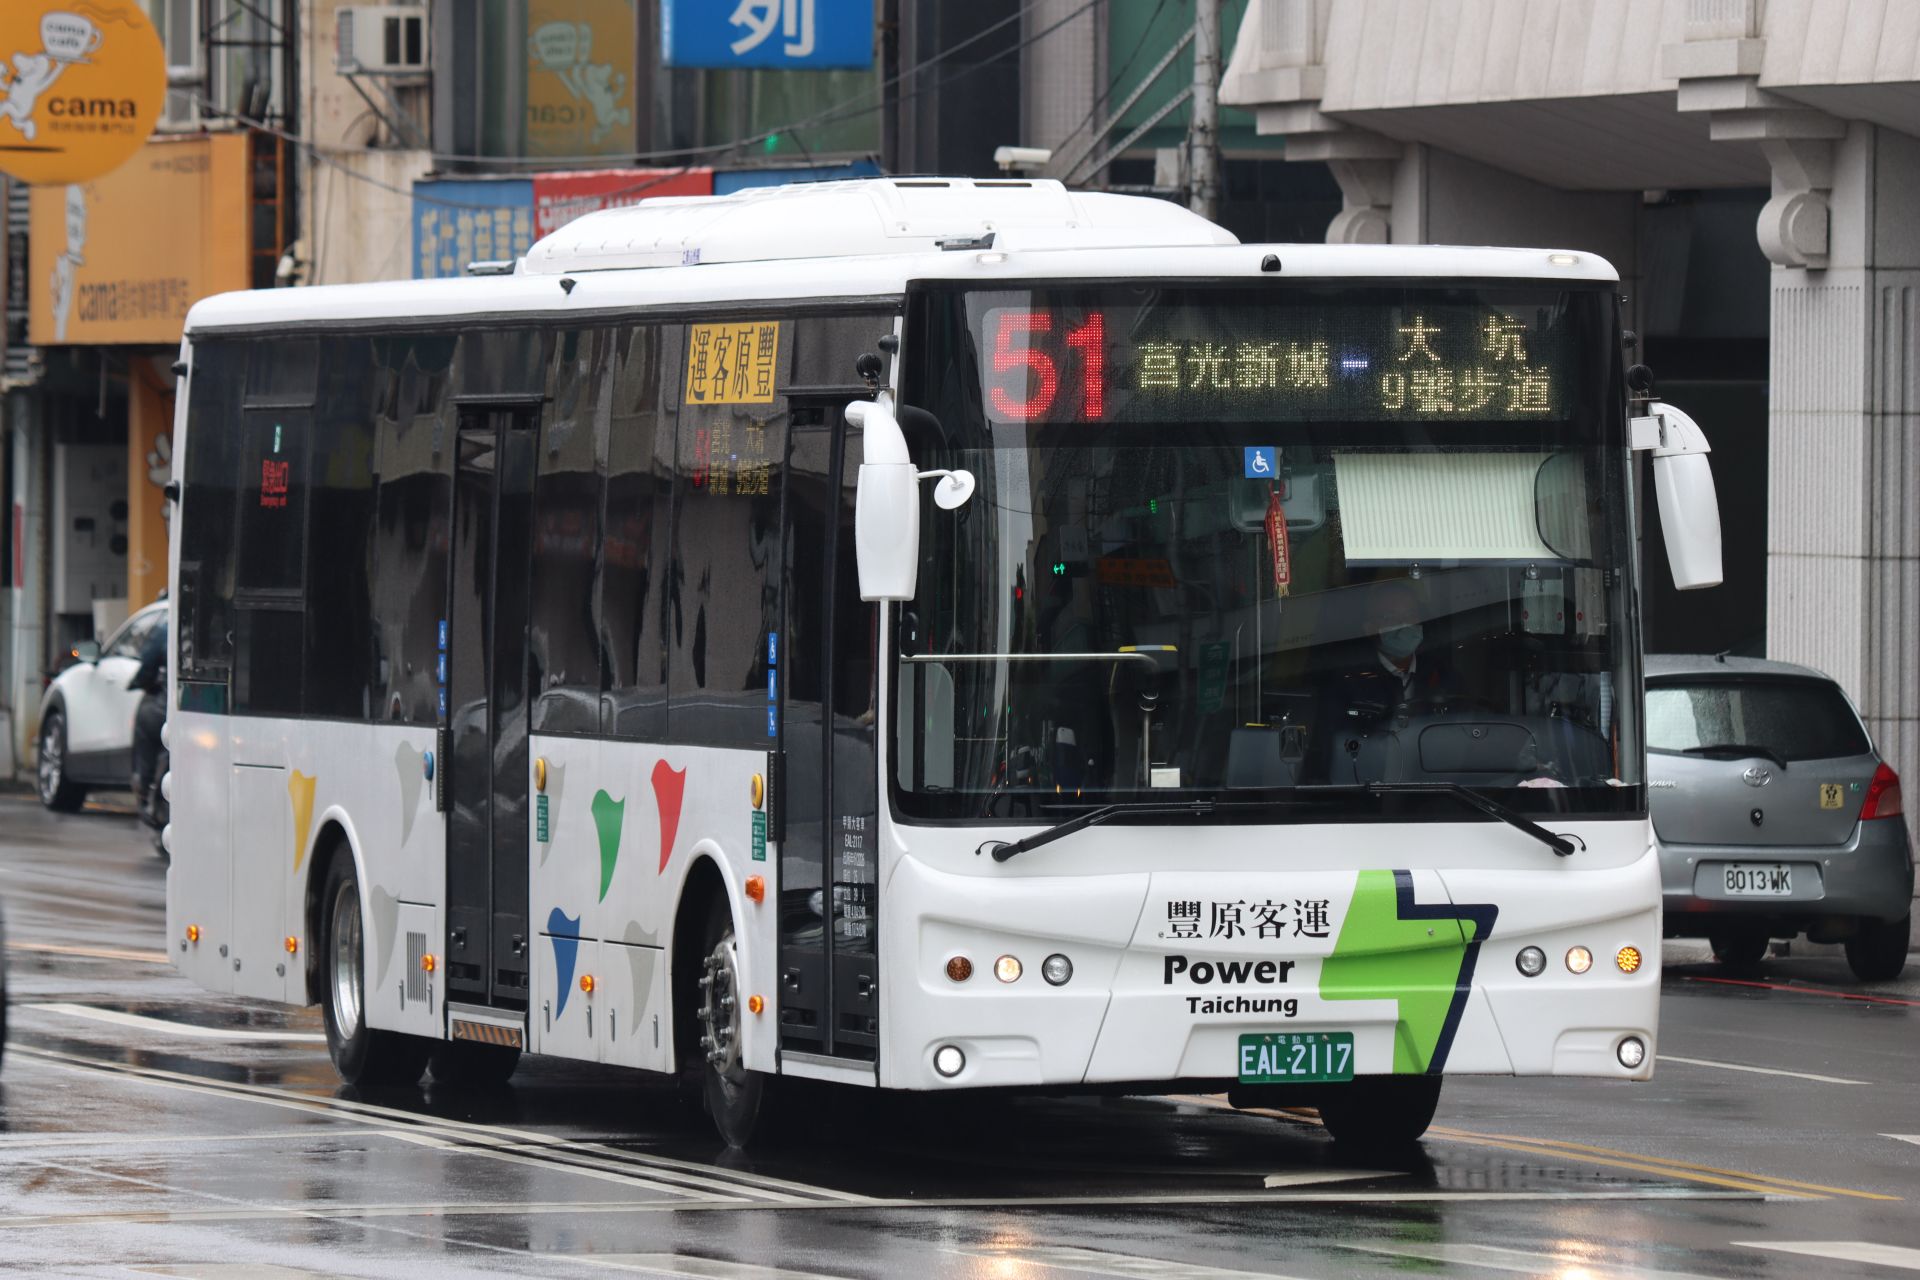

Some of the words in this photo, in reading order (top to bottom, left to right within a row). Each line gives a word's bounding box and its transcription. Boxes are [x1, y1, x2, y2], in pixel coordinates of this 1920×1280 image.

[48, 97, 137, 118] cama
[991, 312, 1103, 417] 51
[1166, 899, 1331, 940] 豐原客運
[1163, 955, 1296, 985] Power
[1186, 996, 1299, 1017] Taichung
[1277, 1034, 1316, 1046] 電動車
